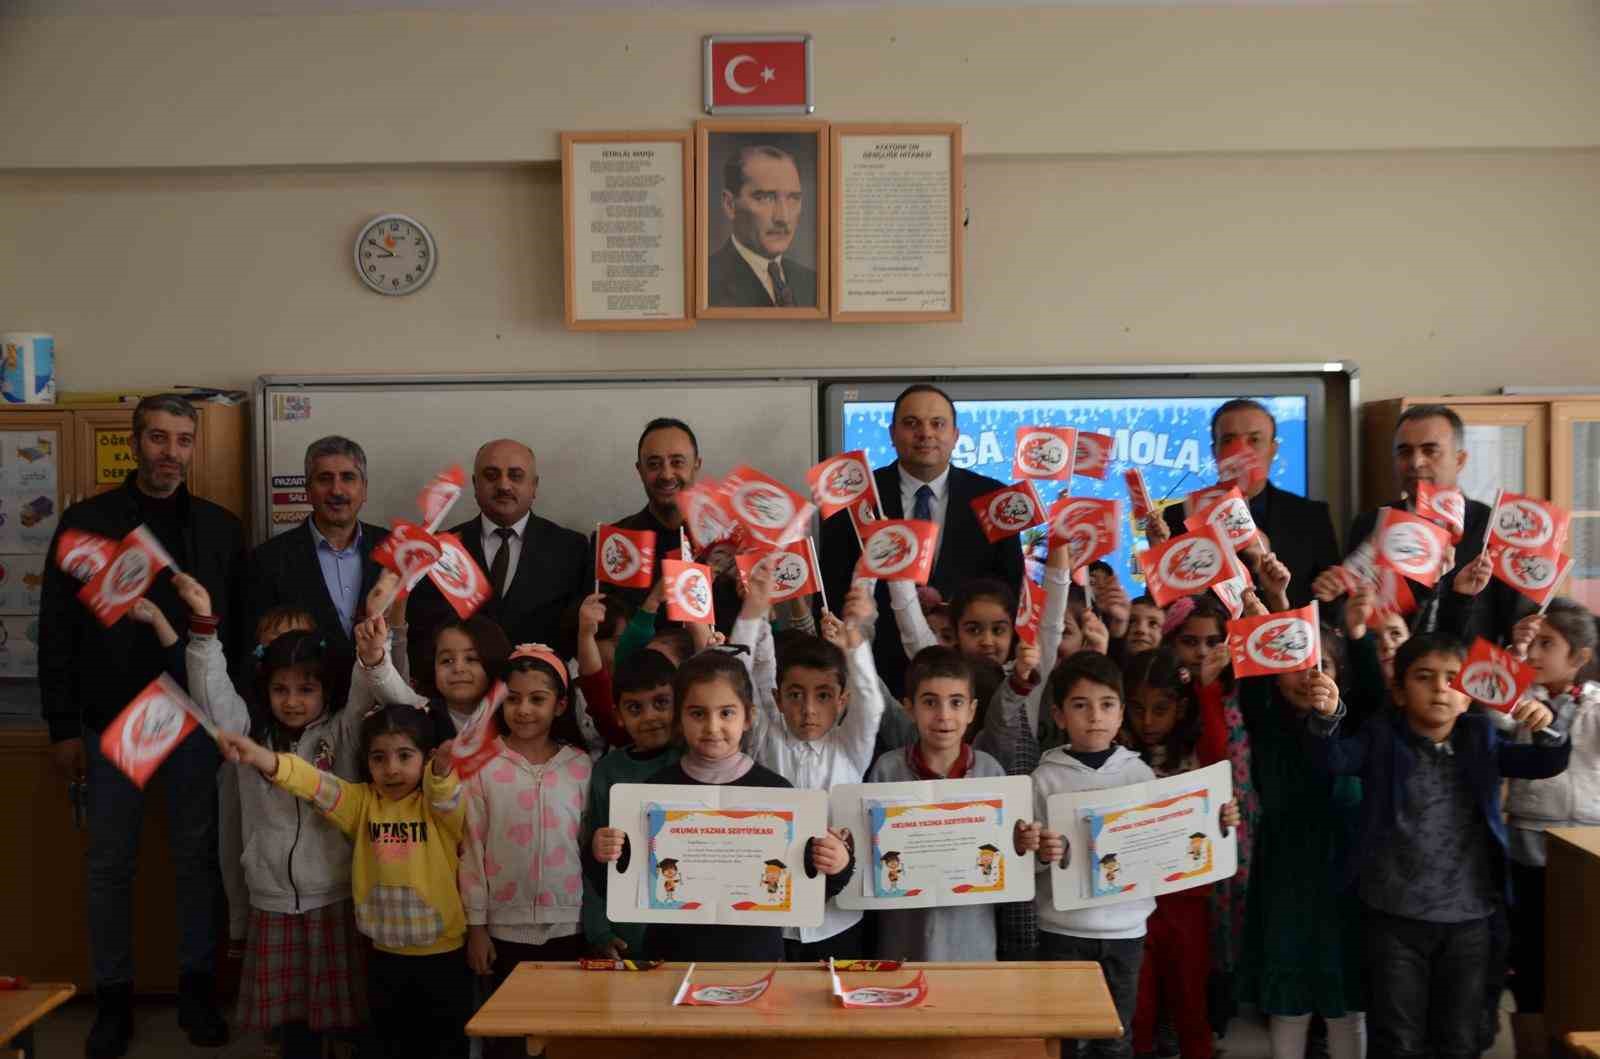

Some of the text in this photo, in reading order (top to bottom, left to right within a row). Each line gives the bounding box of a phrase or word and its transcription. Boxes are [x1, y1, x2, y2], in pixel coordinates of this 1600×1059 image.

[951, 431, 1005, 469] SA
[670, 826, 698, 835] OKUMA
[700, 826, 727, 835] YAZMA
